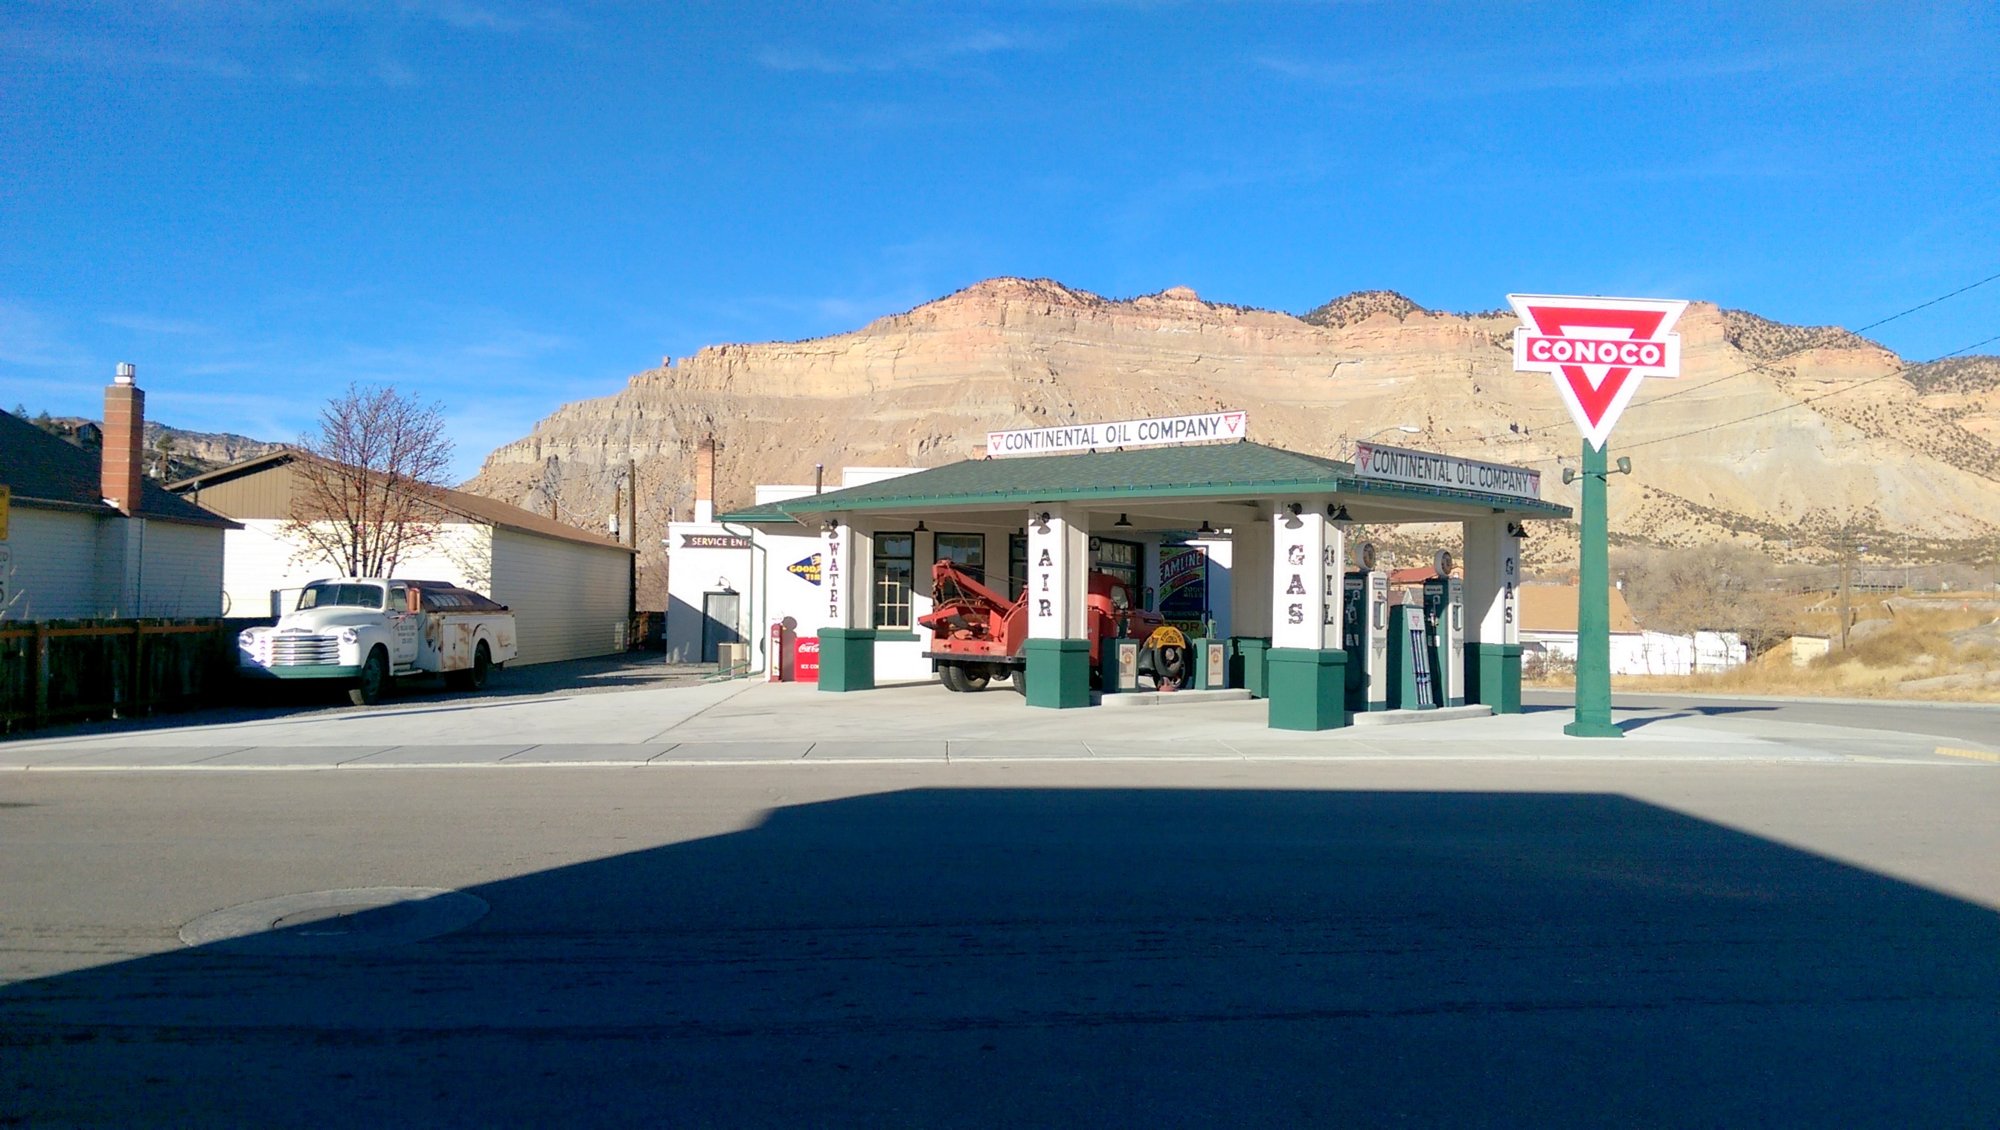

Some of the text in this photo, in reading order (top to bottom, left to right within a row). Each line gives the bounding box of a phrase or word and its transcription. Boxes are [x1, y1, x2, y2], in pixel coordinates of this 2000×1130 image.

[1532, 339, 1661, 365] CONOCO
[1005, 415, 1222, 450] CONTINENTAL OIL COMPANY
[1373, 449, 1529, 493] CONTINENTAL OIL COMPANY
[692, 537, 728, 546] SERVICE
[829, 542, 840, 618] WATER
[1038, 548, 1053, 617] AIR
[1286, 544, 1307, 625] GAS
[1324, 545, 1335, 625] OIL
[1505, 557, 1514, 625] GAS
